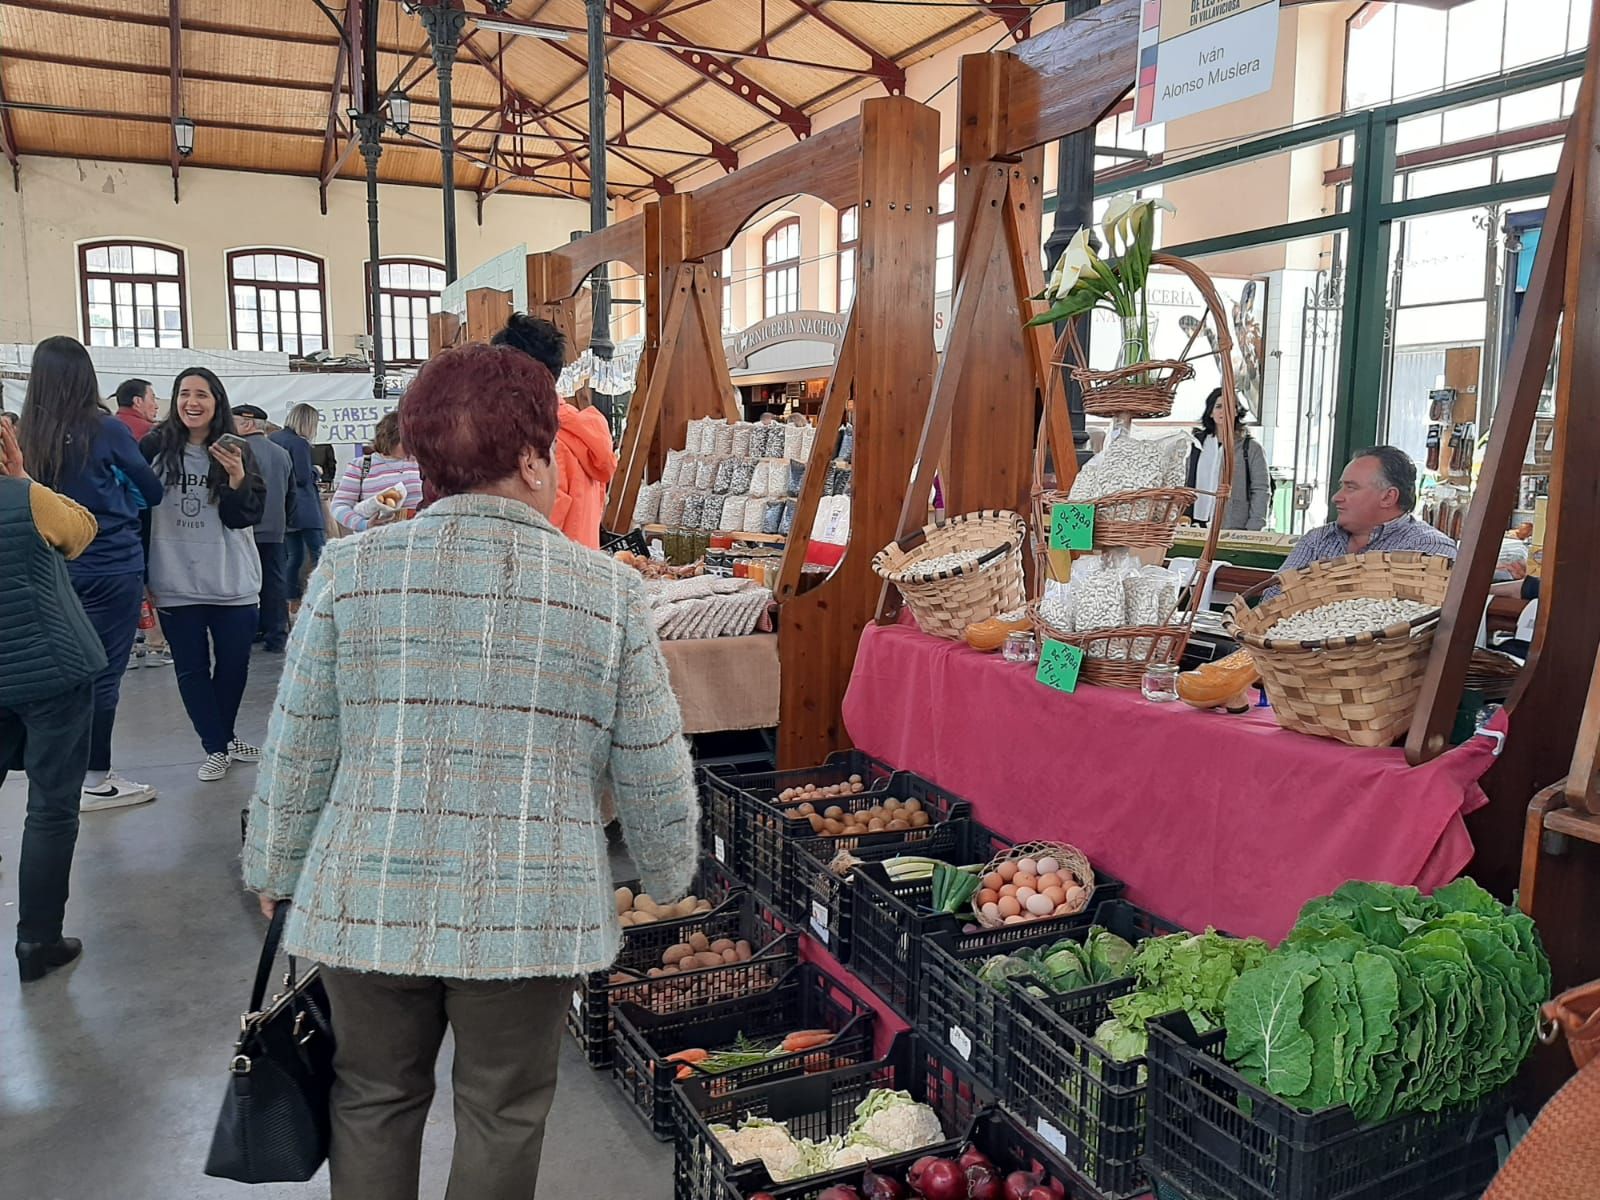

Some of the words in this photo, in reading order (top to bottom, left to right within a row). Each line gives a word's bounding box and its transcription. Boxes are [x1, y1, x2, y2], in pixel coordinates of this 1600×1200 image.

[1190, 13, 1198, 26] EN
[1199, 0, 1240, 22] VILLAVICIOSA
[1198, 46, 1225, 67] Iván
[1162, 76, 1204, 101] Alonso
[1208, 58, 1260, 87] Muslera
[799, 316, 845, 339] NACHÓN
[333, 406, 379, 422] FABES
[1070, 505, 1091, 528] FABA
[1061, 644, 1078, 671] FABA
